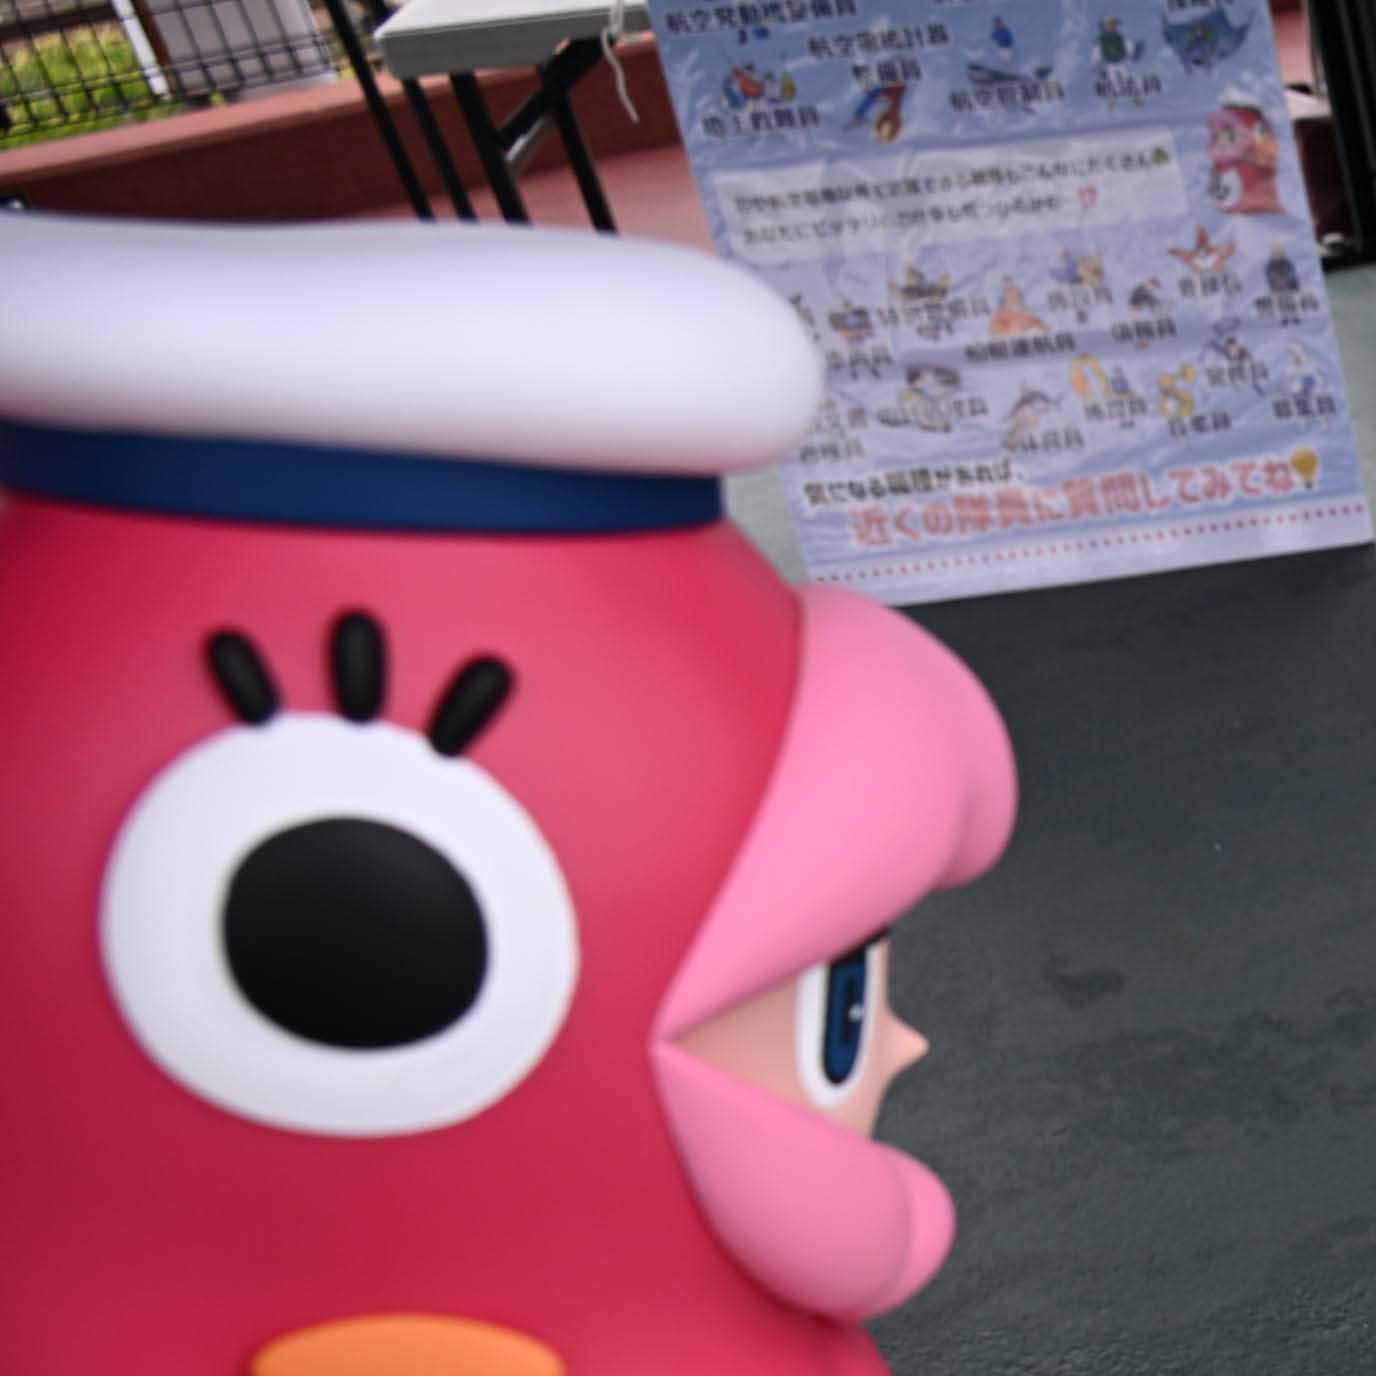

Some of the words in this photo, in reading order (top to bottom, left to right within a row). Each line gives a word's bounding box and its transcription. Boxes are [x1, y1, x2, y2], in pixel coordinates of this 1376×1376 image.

[849, 458, 1295, 550] 近くの隊員に質問してみてね
